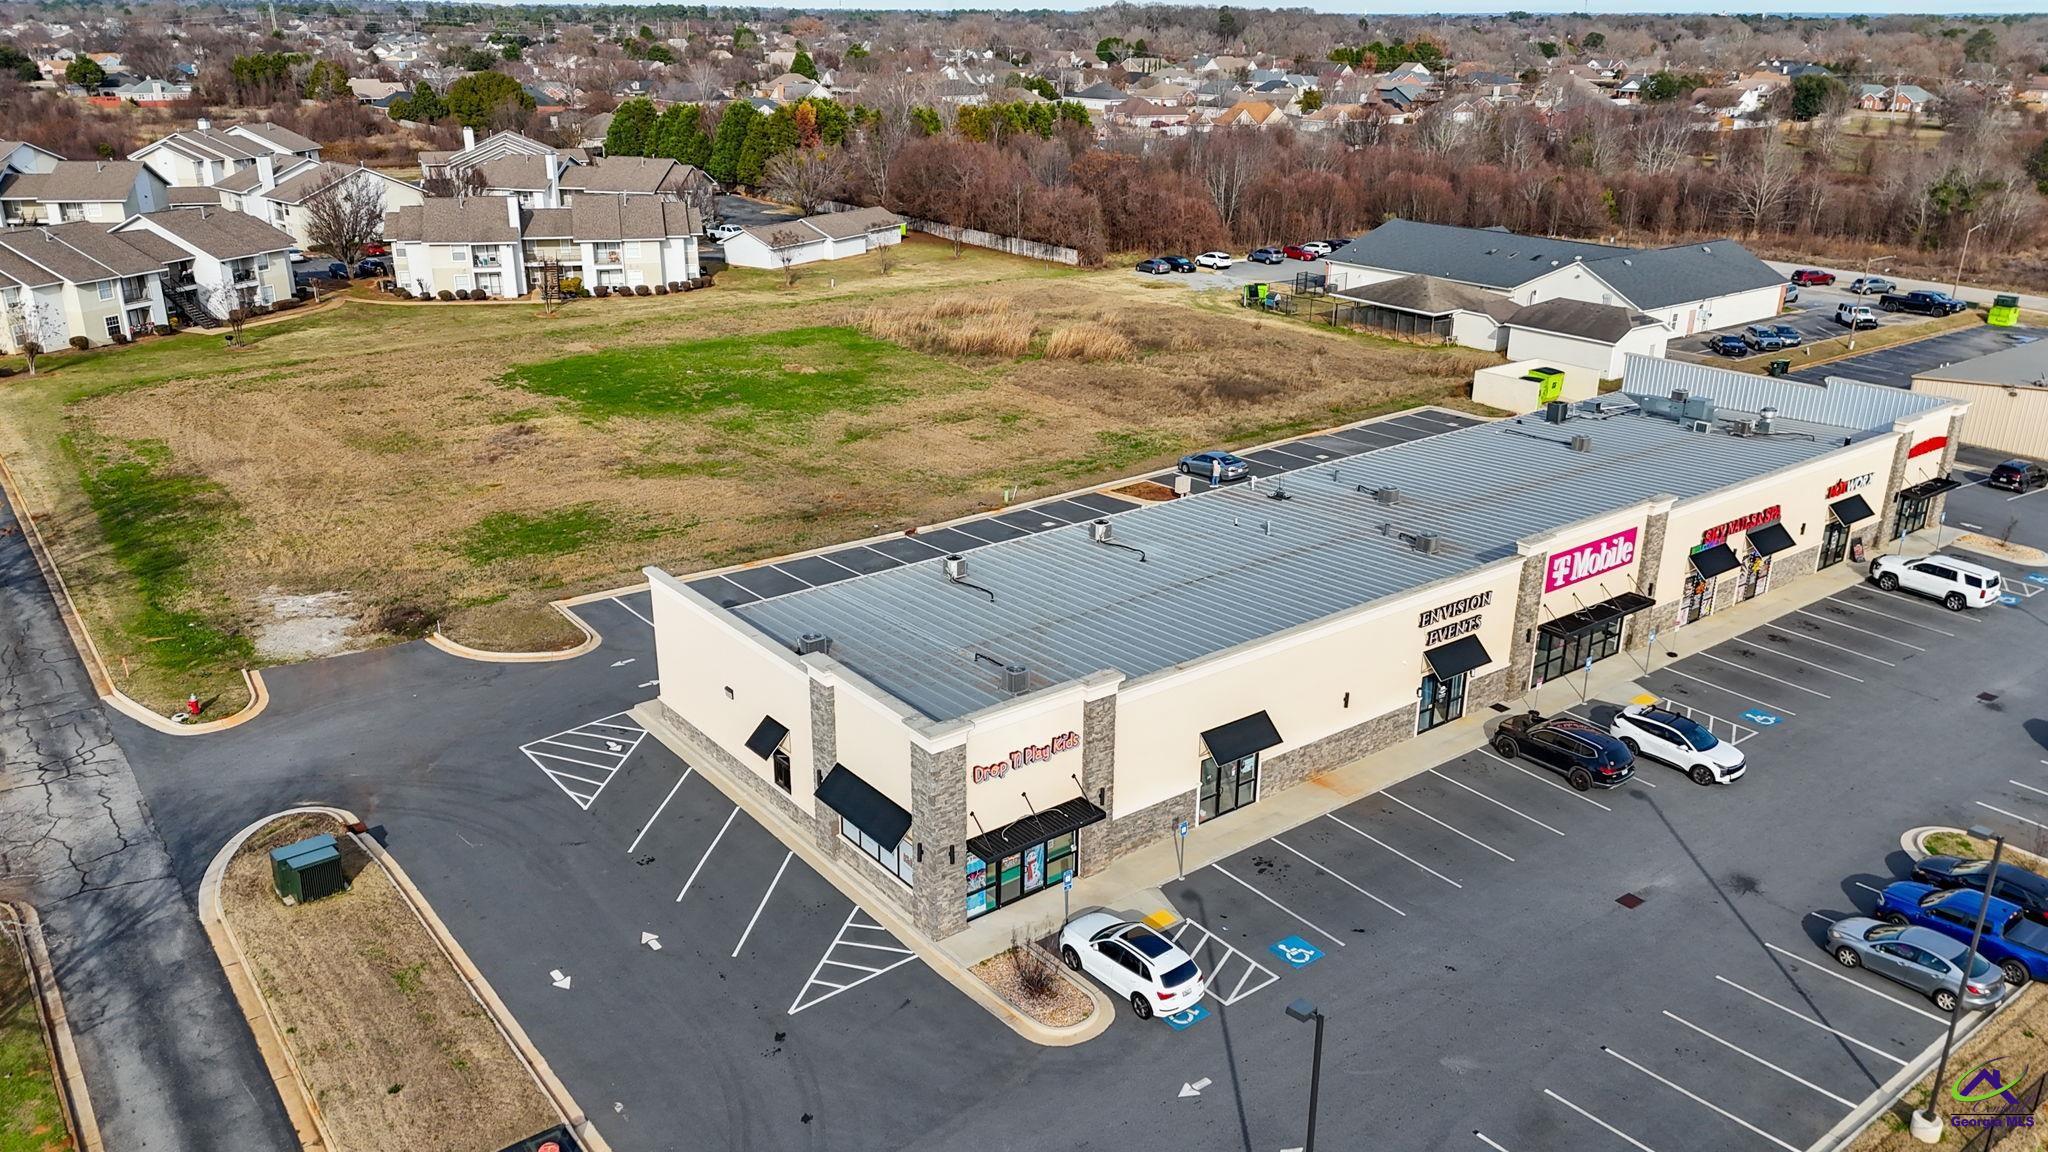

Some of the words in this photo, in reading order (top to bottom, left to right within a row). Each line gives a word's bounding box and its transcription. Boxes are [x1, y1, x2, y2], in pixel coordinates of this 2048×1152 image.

[1702, 523, 1728, 543] SKY
[1569, 536, 1634, 581] Mobile
[1418, 590, 1493, 628] ENVISION
[1425, 614, 1482, 646] EVENTS
[973, 761, 1009, 784] Drop
[1024, 745, 1052, 766] Play
[1051, 731, 1080, 755] Kids
